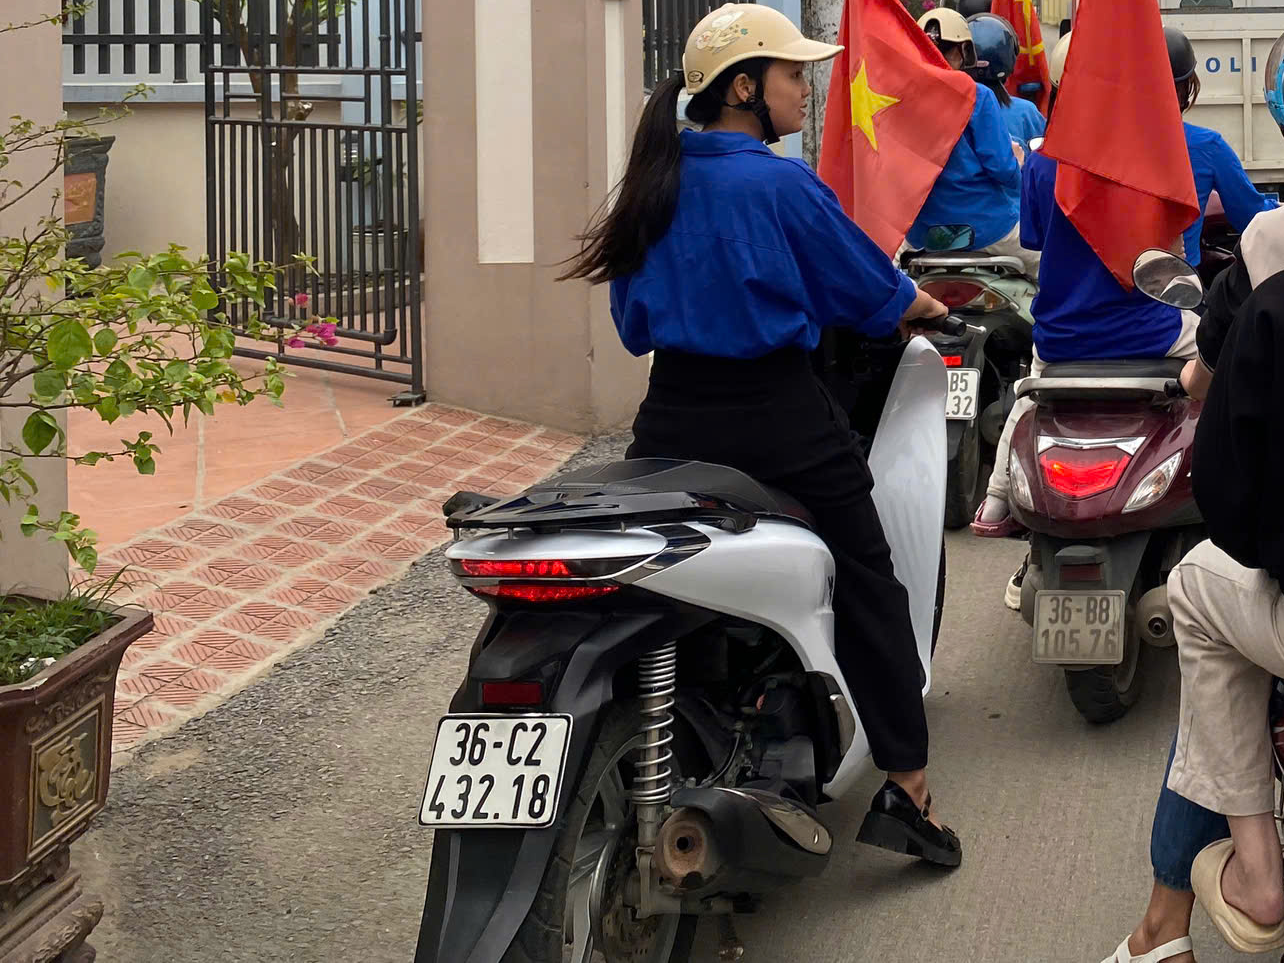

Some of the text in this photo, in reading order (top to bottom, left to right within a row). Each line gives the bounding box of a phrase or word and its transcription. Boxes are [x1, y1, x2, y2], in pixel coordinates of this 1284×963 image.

[1048, 596, 1111, 625] 36-B8
[449, 722, 548, 766] 36-C2
[428, 774, 551, 820] 432.18
